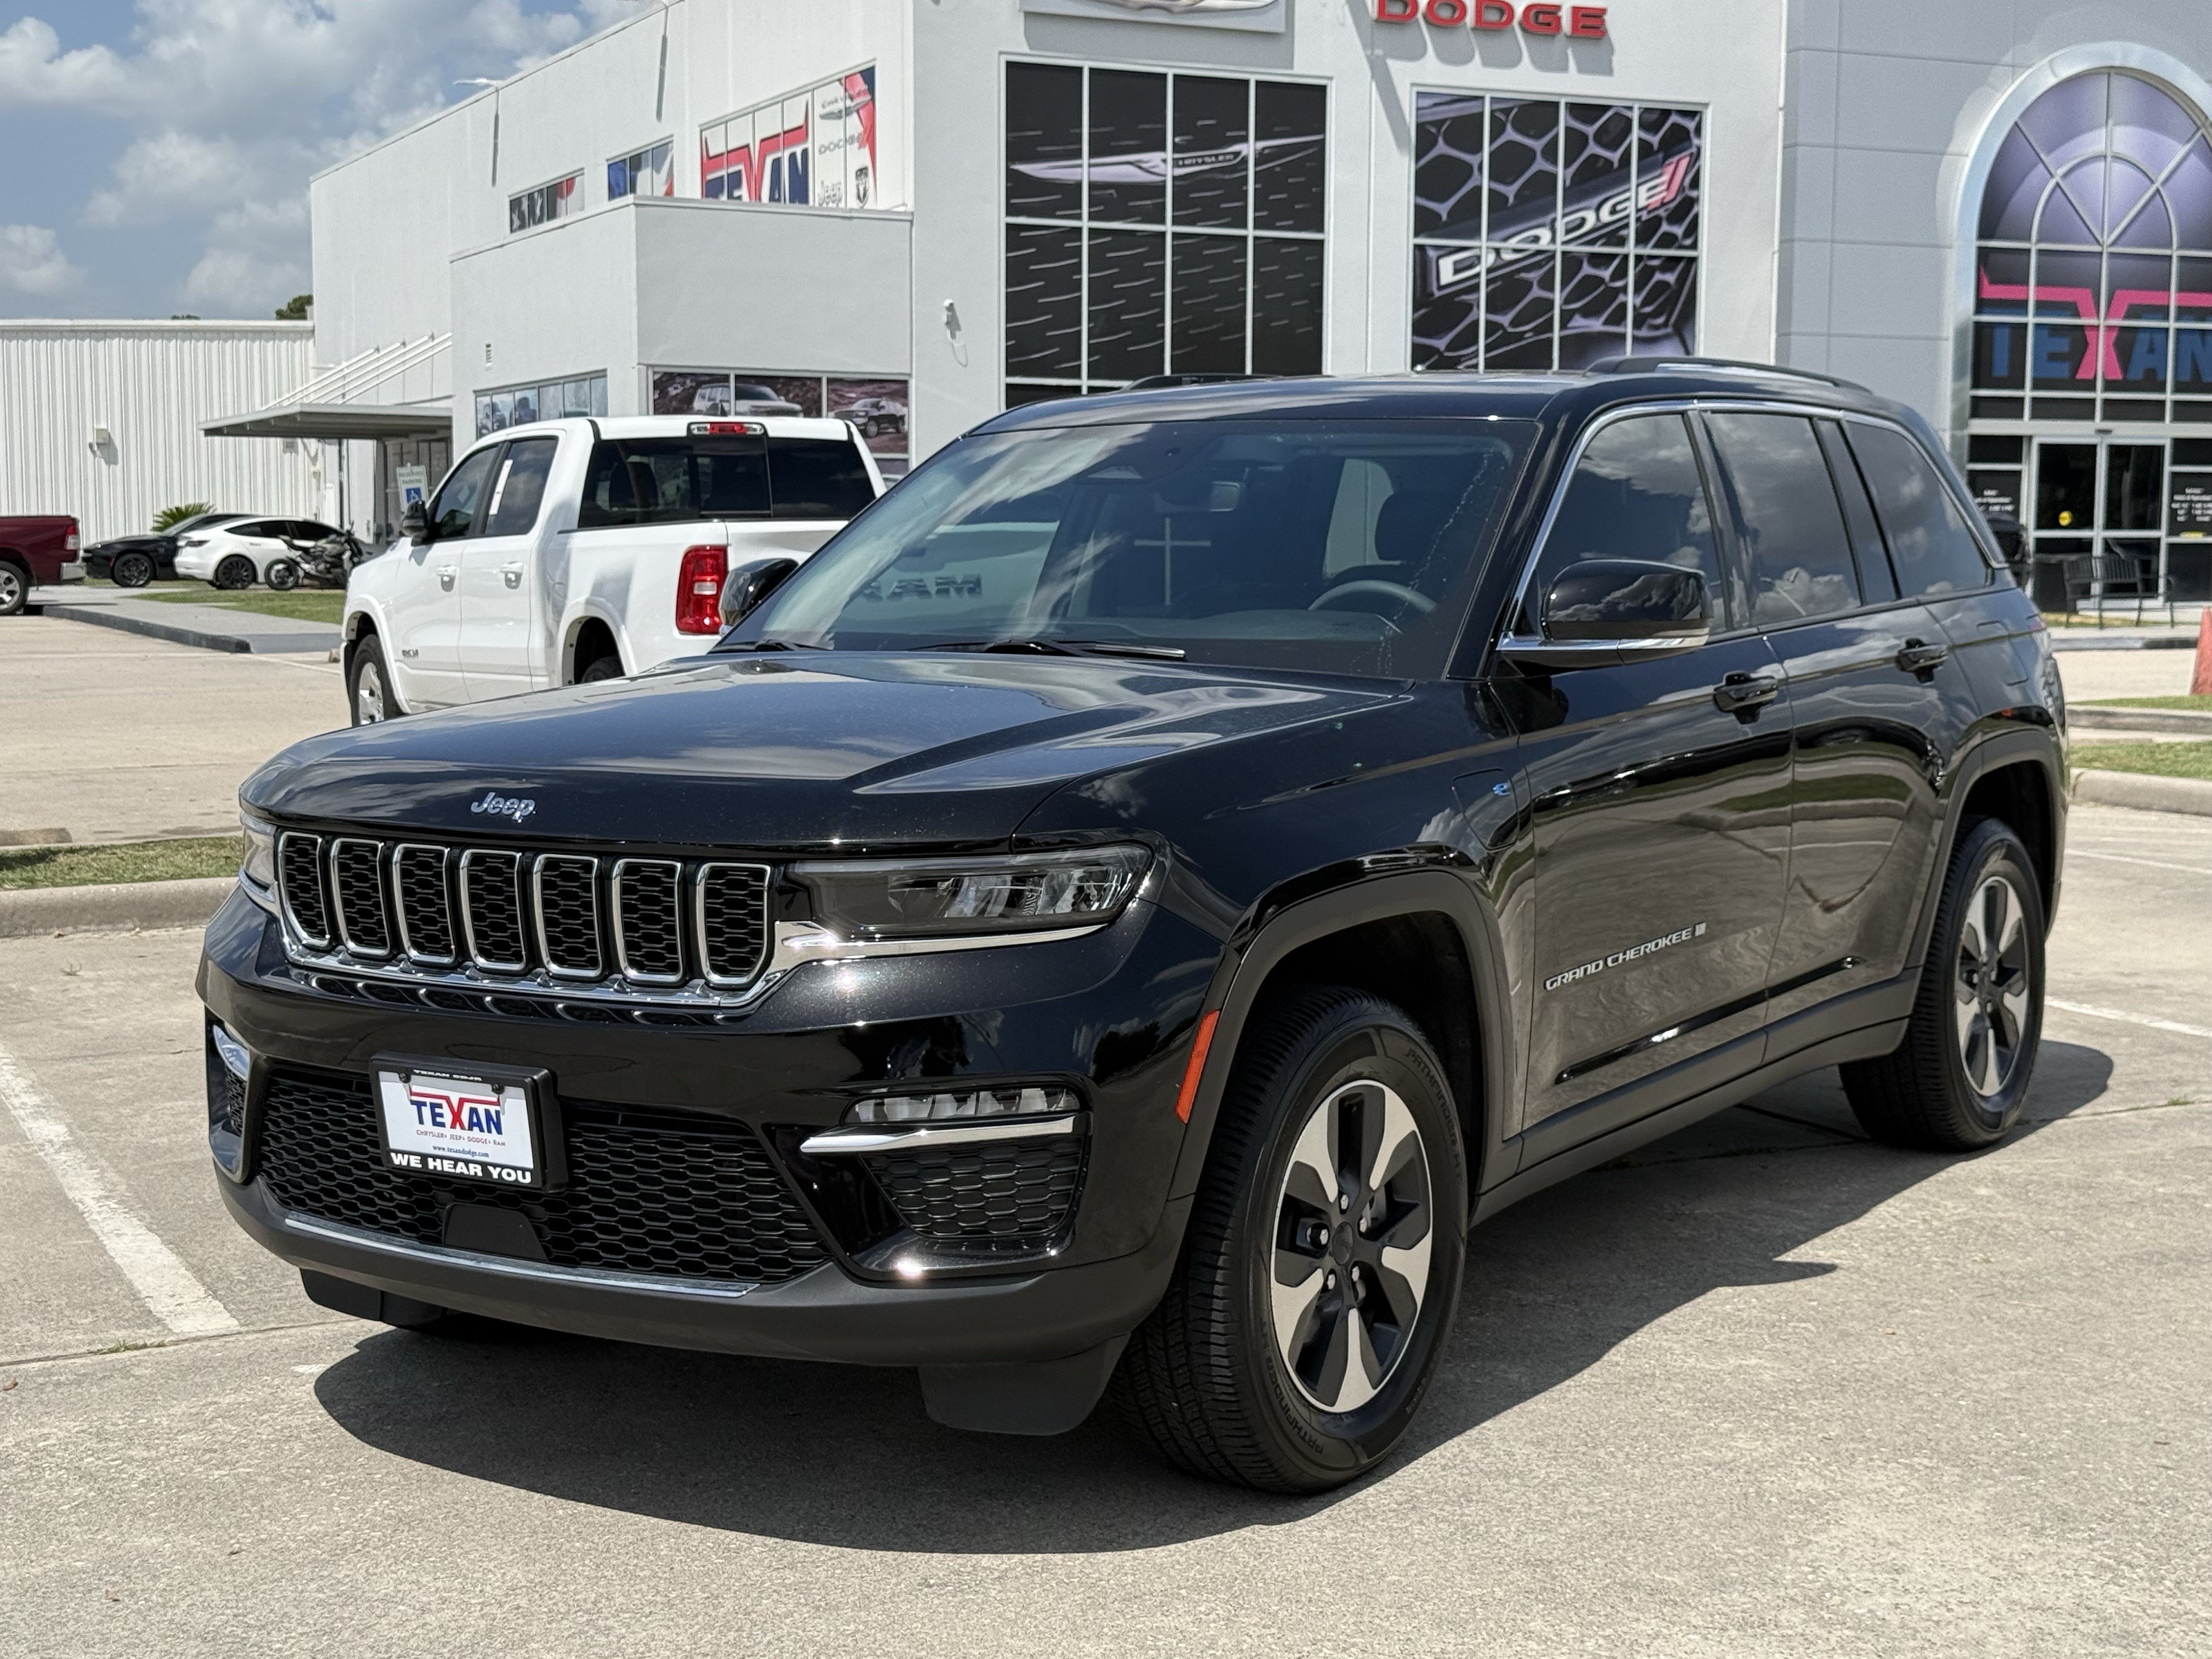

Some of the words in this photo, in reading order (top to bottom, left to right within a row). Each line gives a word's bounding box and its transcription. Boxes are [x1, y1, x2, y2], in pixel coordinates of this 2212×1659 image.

[1376, 0, 1607, 38] DODGE
[1437, 173, 1669, 286] DODGE
[1979, 263, 2212, 382] TEXAN
[471, 792, 536, 822] Jeep
[1545, 959, 1603, 991] GRAND
[1606, 927, 1692, 968] CHEROKEE
[409, 1084, 503, 1135] TEXAN
[416, 1129, 444, 1138] CHRYSLER
[467, 1136, 488, 1144] DODGE
[390, 1152, 422, 1169] WE
[427, 1158, 482, 1177] HEAR
[487, 1165, 532, 1184] YOU
